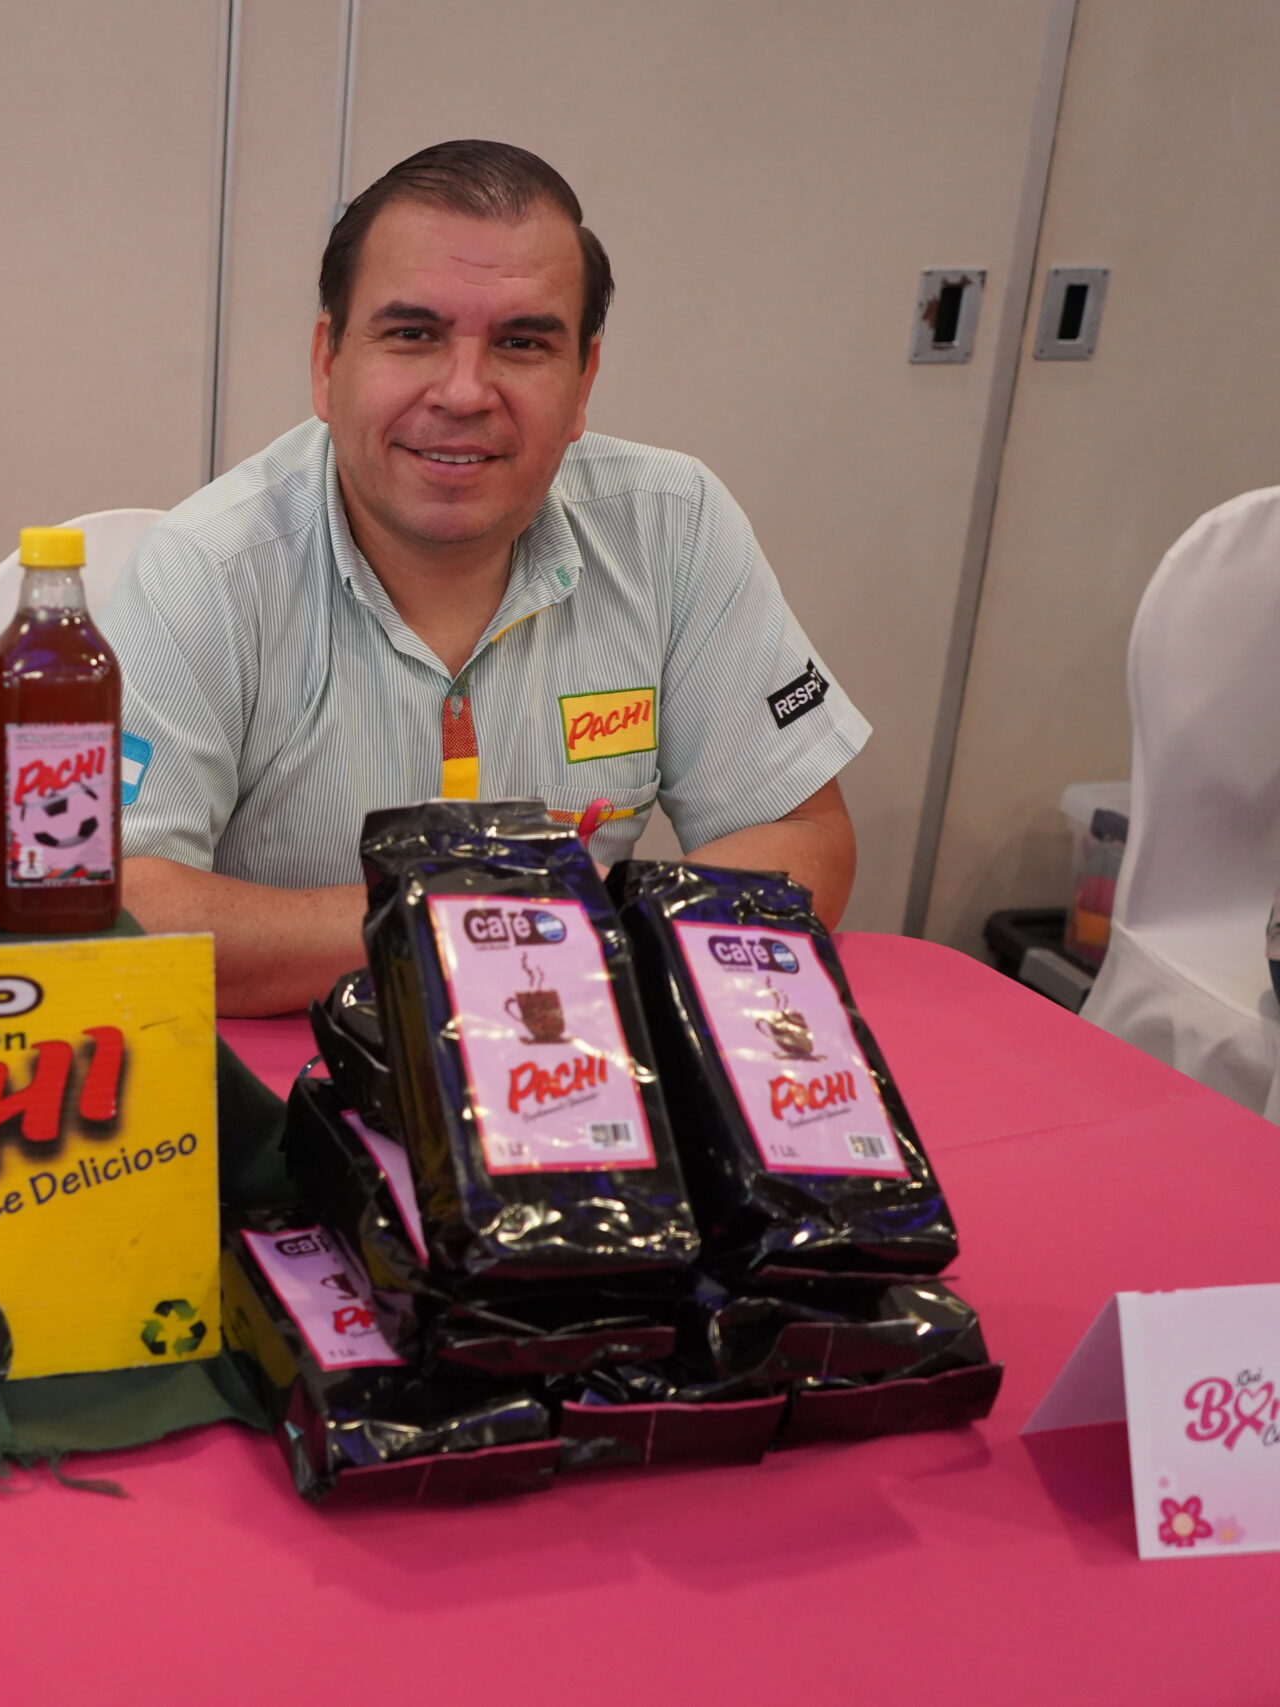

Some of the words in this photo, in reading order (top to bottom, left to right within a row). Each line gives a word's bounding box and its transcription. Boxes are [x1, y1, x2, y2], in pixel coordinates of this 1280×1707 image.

[568, 700, 651, 750] PACHI
[14, 746, 106, 806] PACHI
[508, 1055, 609, 1113] PACHI
[767, 1070, 858, 1120] PACHI
[28, 1131, 198, 1206] Delicioso
